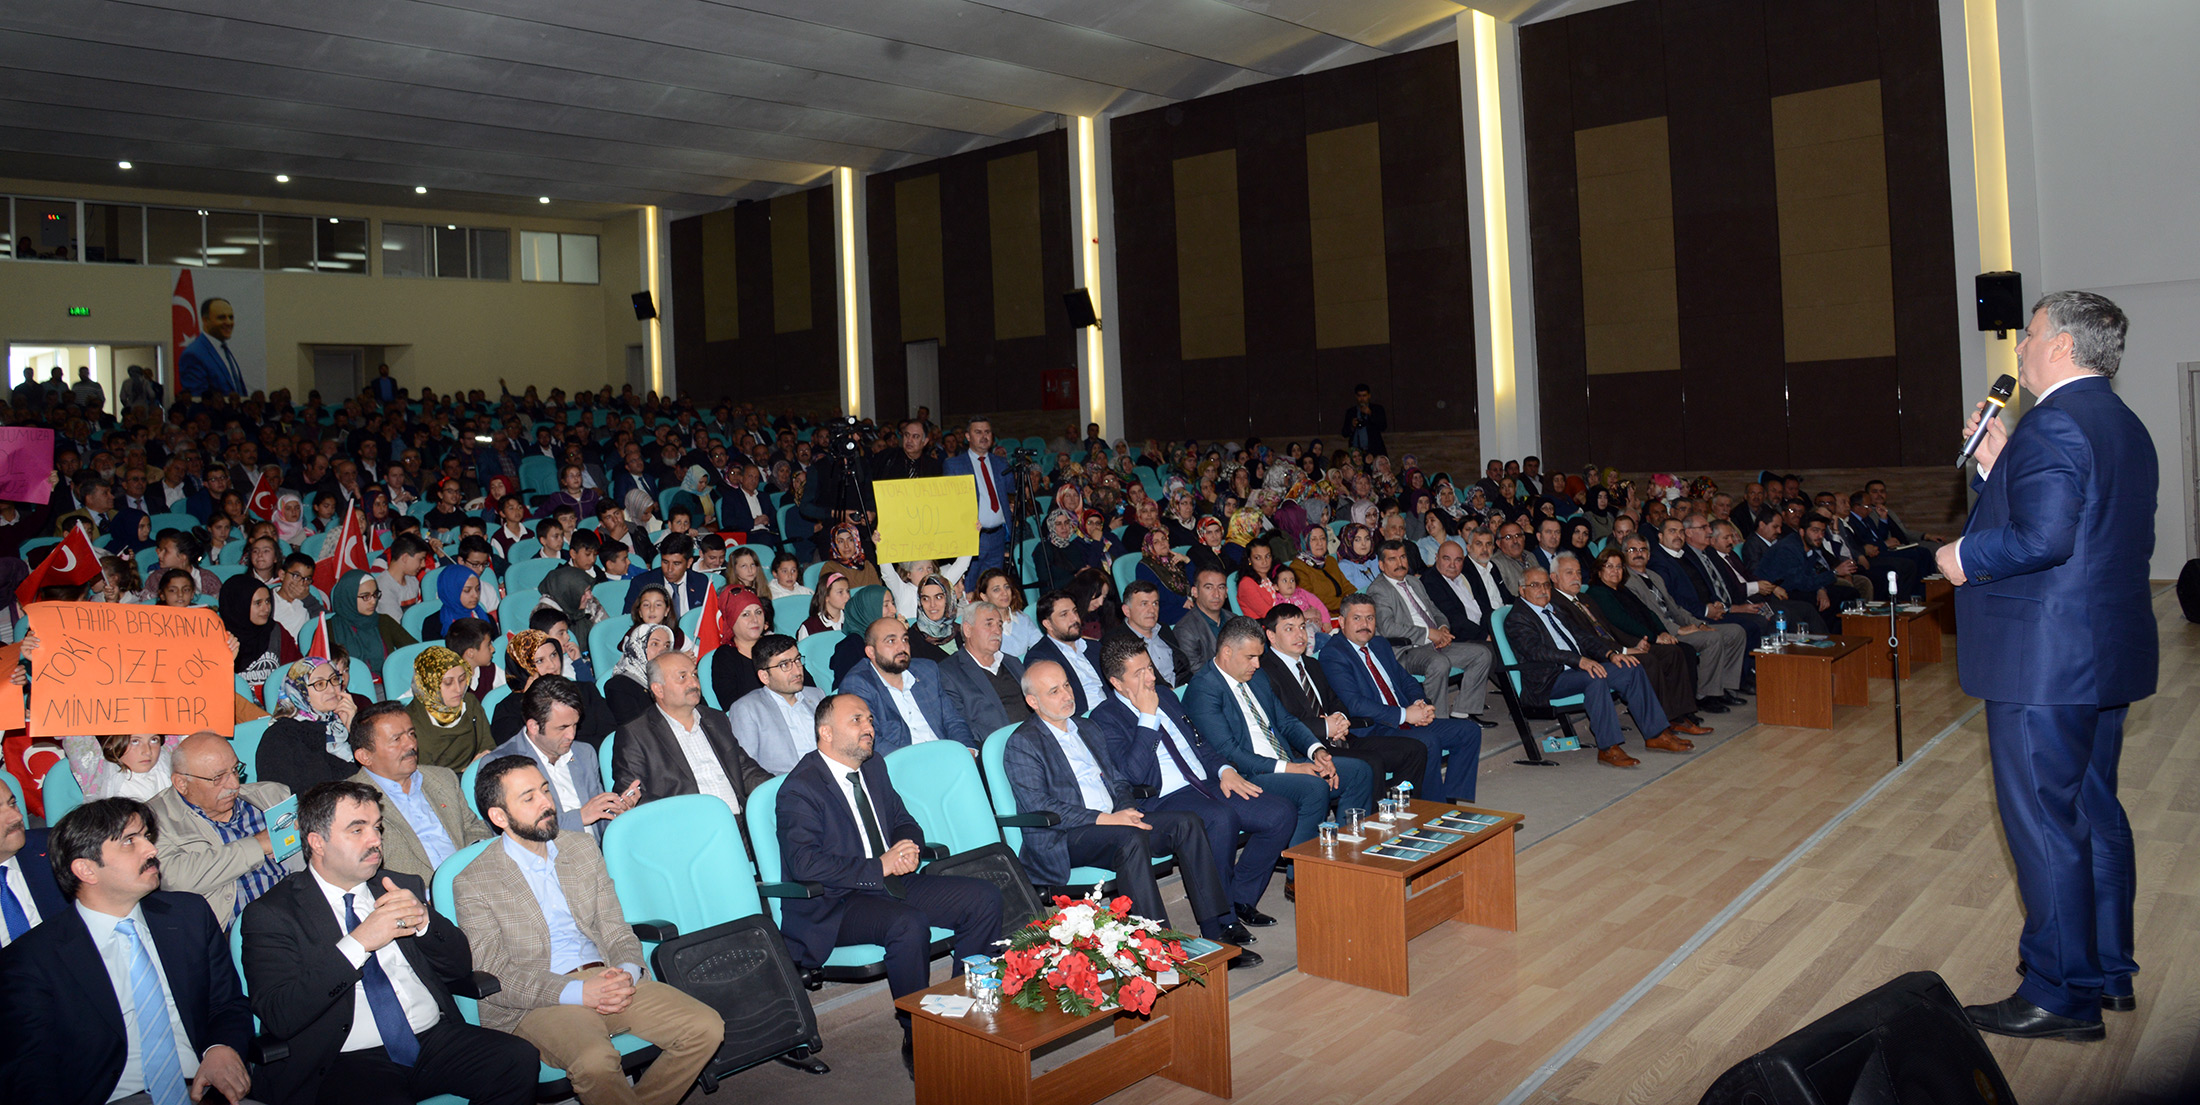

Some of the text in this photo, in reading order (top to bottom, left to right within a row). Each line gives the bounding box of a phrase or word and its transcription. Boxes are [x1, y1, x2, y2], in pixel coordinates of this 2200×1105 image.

[906, 503, 954, 536] YOL
[42, 605, 226, 643] TAHİR BAŞKANIM
[36, 633, 95, 685] TOKİ
[96, 643, 167, 686] SİZE
[177, 648, 219, 686] ÇOK
[42, 694, 209, 728] MİNNETTAR
